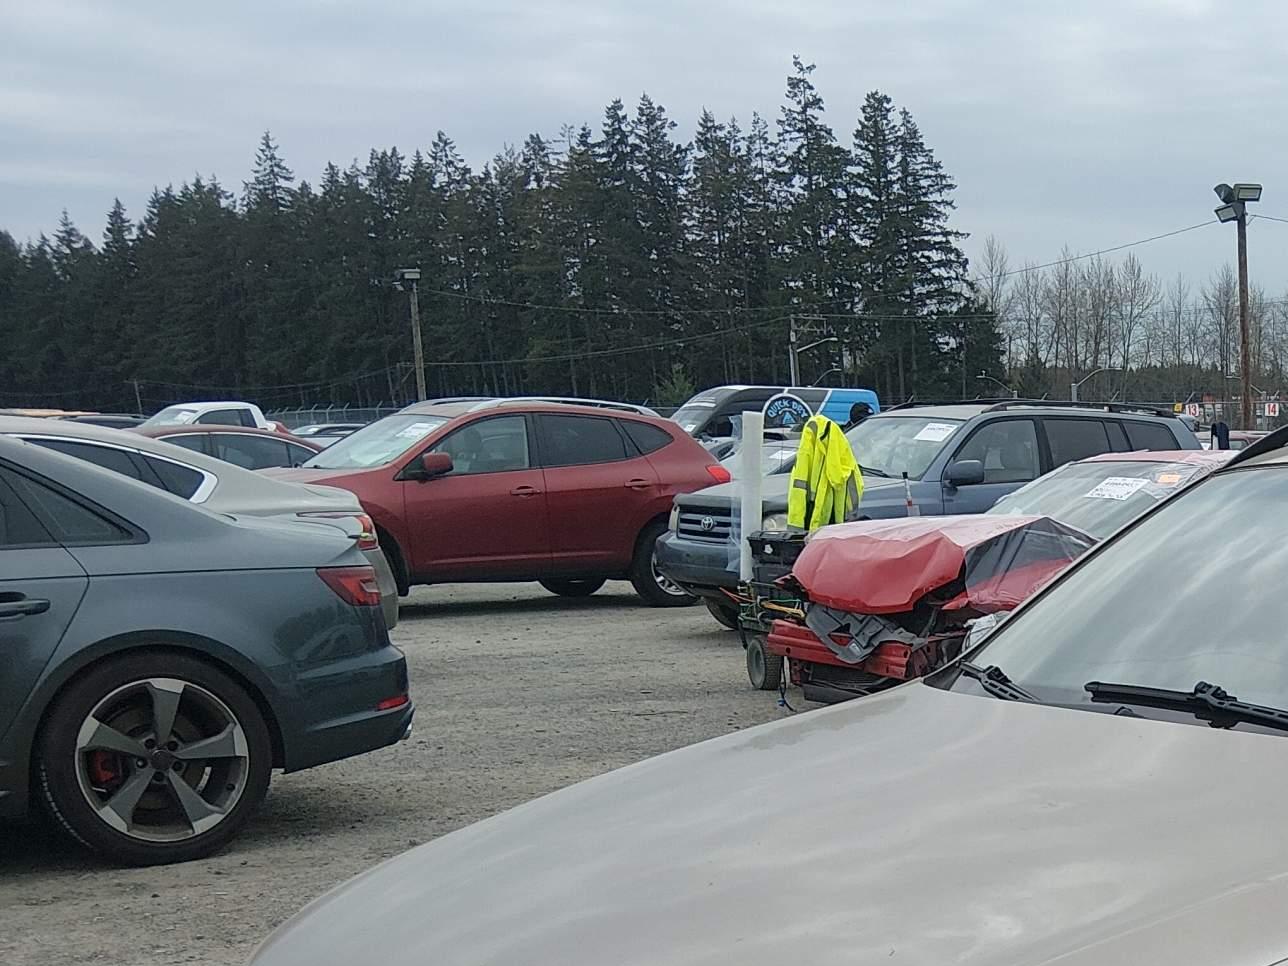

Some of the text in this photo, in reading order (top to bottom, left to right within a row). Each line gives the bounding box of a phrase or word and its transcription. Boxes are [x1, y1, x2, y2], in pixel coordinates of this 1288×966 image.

[767, 399, 808, 418] QUICK DRY
[1187, 404, 1198, 416] 13
[1267, 403, 1277, 416] 14
